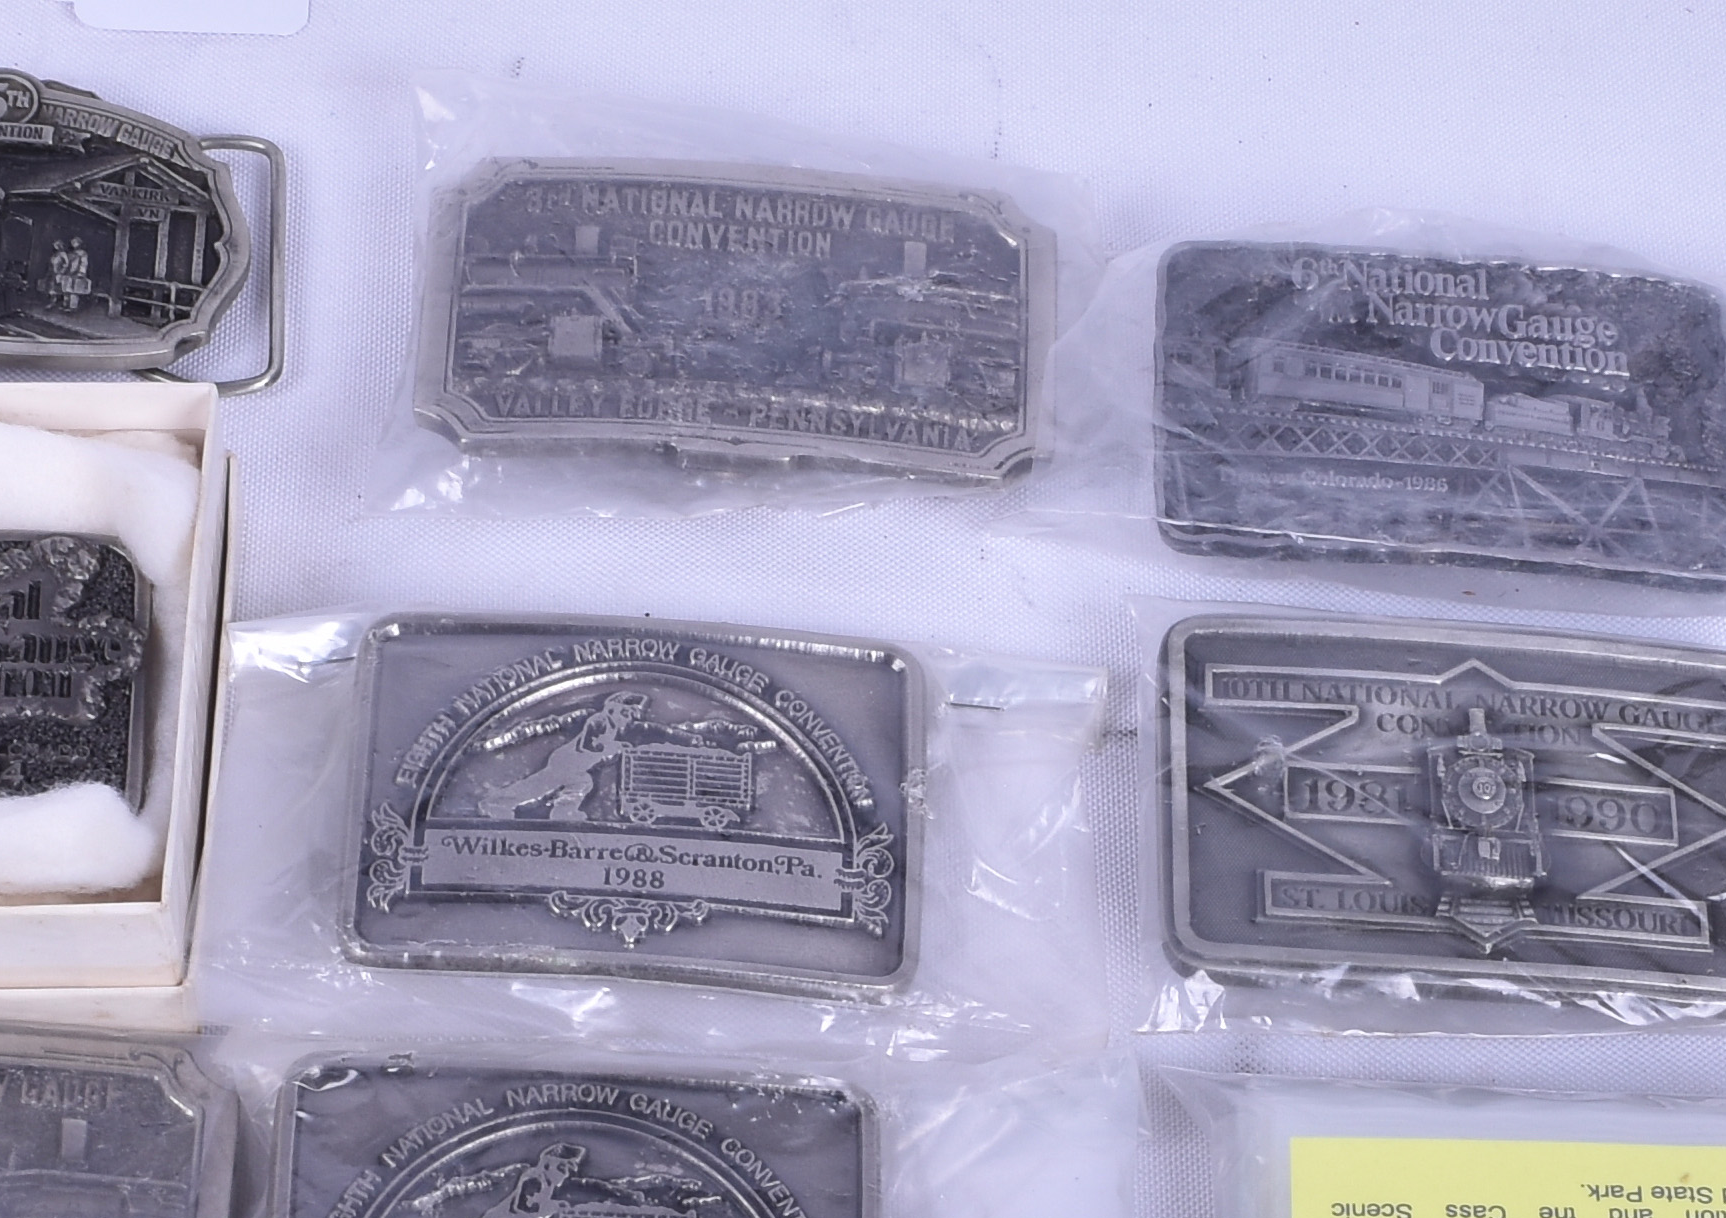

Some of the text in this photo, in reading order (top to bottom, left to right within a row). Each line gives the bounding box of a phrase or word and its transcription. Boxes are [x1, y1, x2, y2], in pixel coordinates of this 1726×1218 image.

[116, 121, 176, 158] GAUGE
[1430, 327, 1631, 378] Convention
[573, 637, 681, 663] NARROW
[689, 648, 770, 696] GAUGE
[603, 866, 666, 890] 1988
[382, 1098, 495, 1167] NATIONAL
[506, 1082, 621, 1108] NARROW
[629, 1092, 715, 1141] GAUGE
